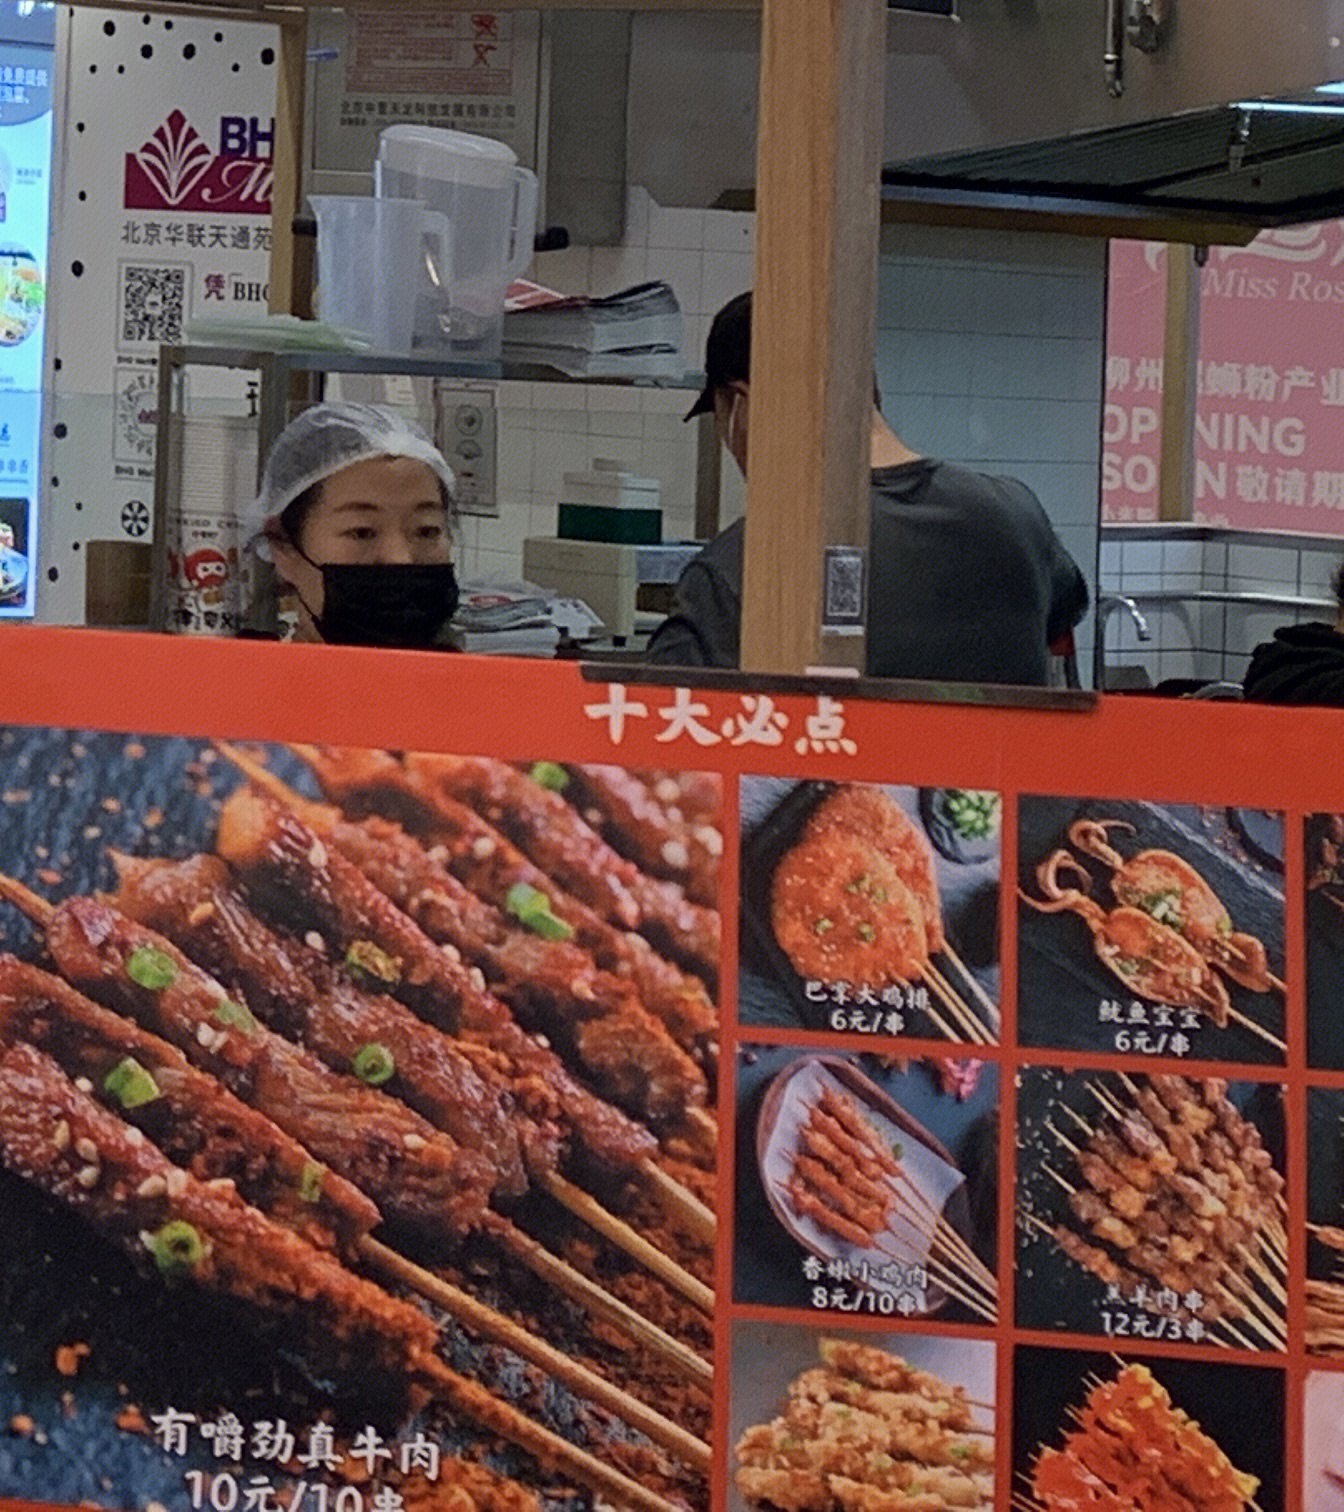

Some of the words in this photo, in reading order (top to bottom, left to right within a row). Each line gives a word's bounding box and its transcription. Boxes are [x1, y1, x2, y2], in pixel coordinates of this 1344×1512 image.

[120, 220, 273, 252] 北京华联天通苑
[1200, 267, 1280, 300] Miss
[1103, 403, 1306, 457] OPNING
[1102, 451, 1228, 500] SON
[584, 682, 859, 757] 十大必点
[831, 1008, 905, 1036] 6元/串
[1115, 1029, 1190, 1058] 6元/串
[812, 1286, 917, 1318] 8元/10串
[1101, 1311, 1205, 1344] 12元/3串
[152, 1405, 442, 1482] 有嚼劲真牛肉
